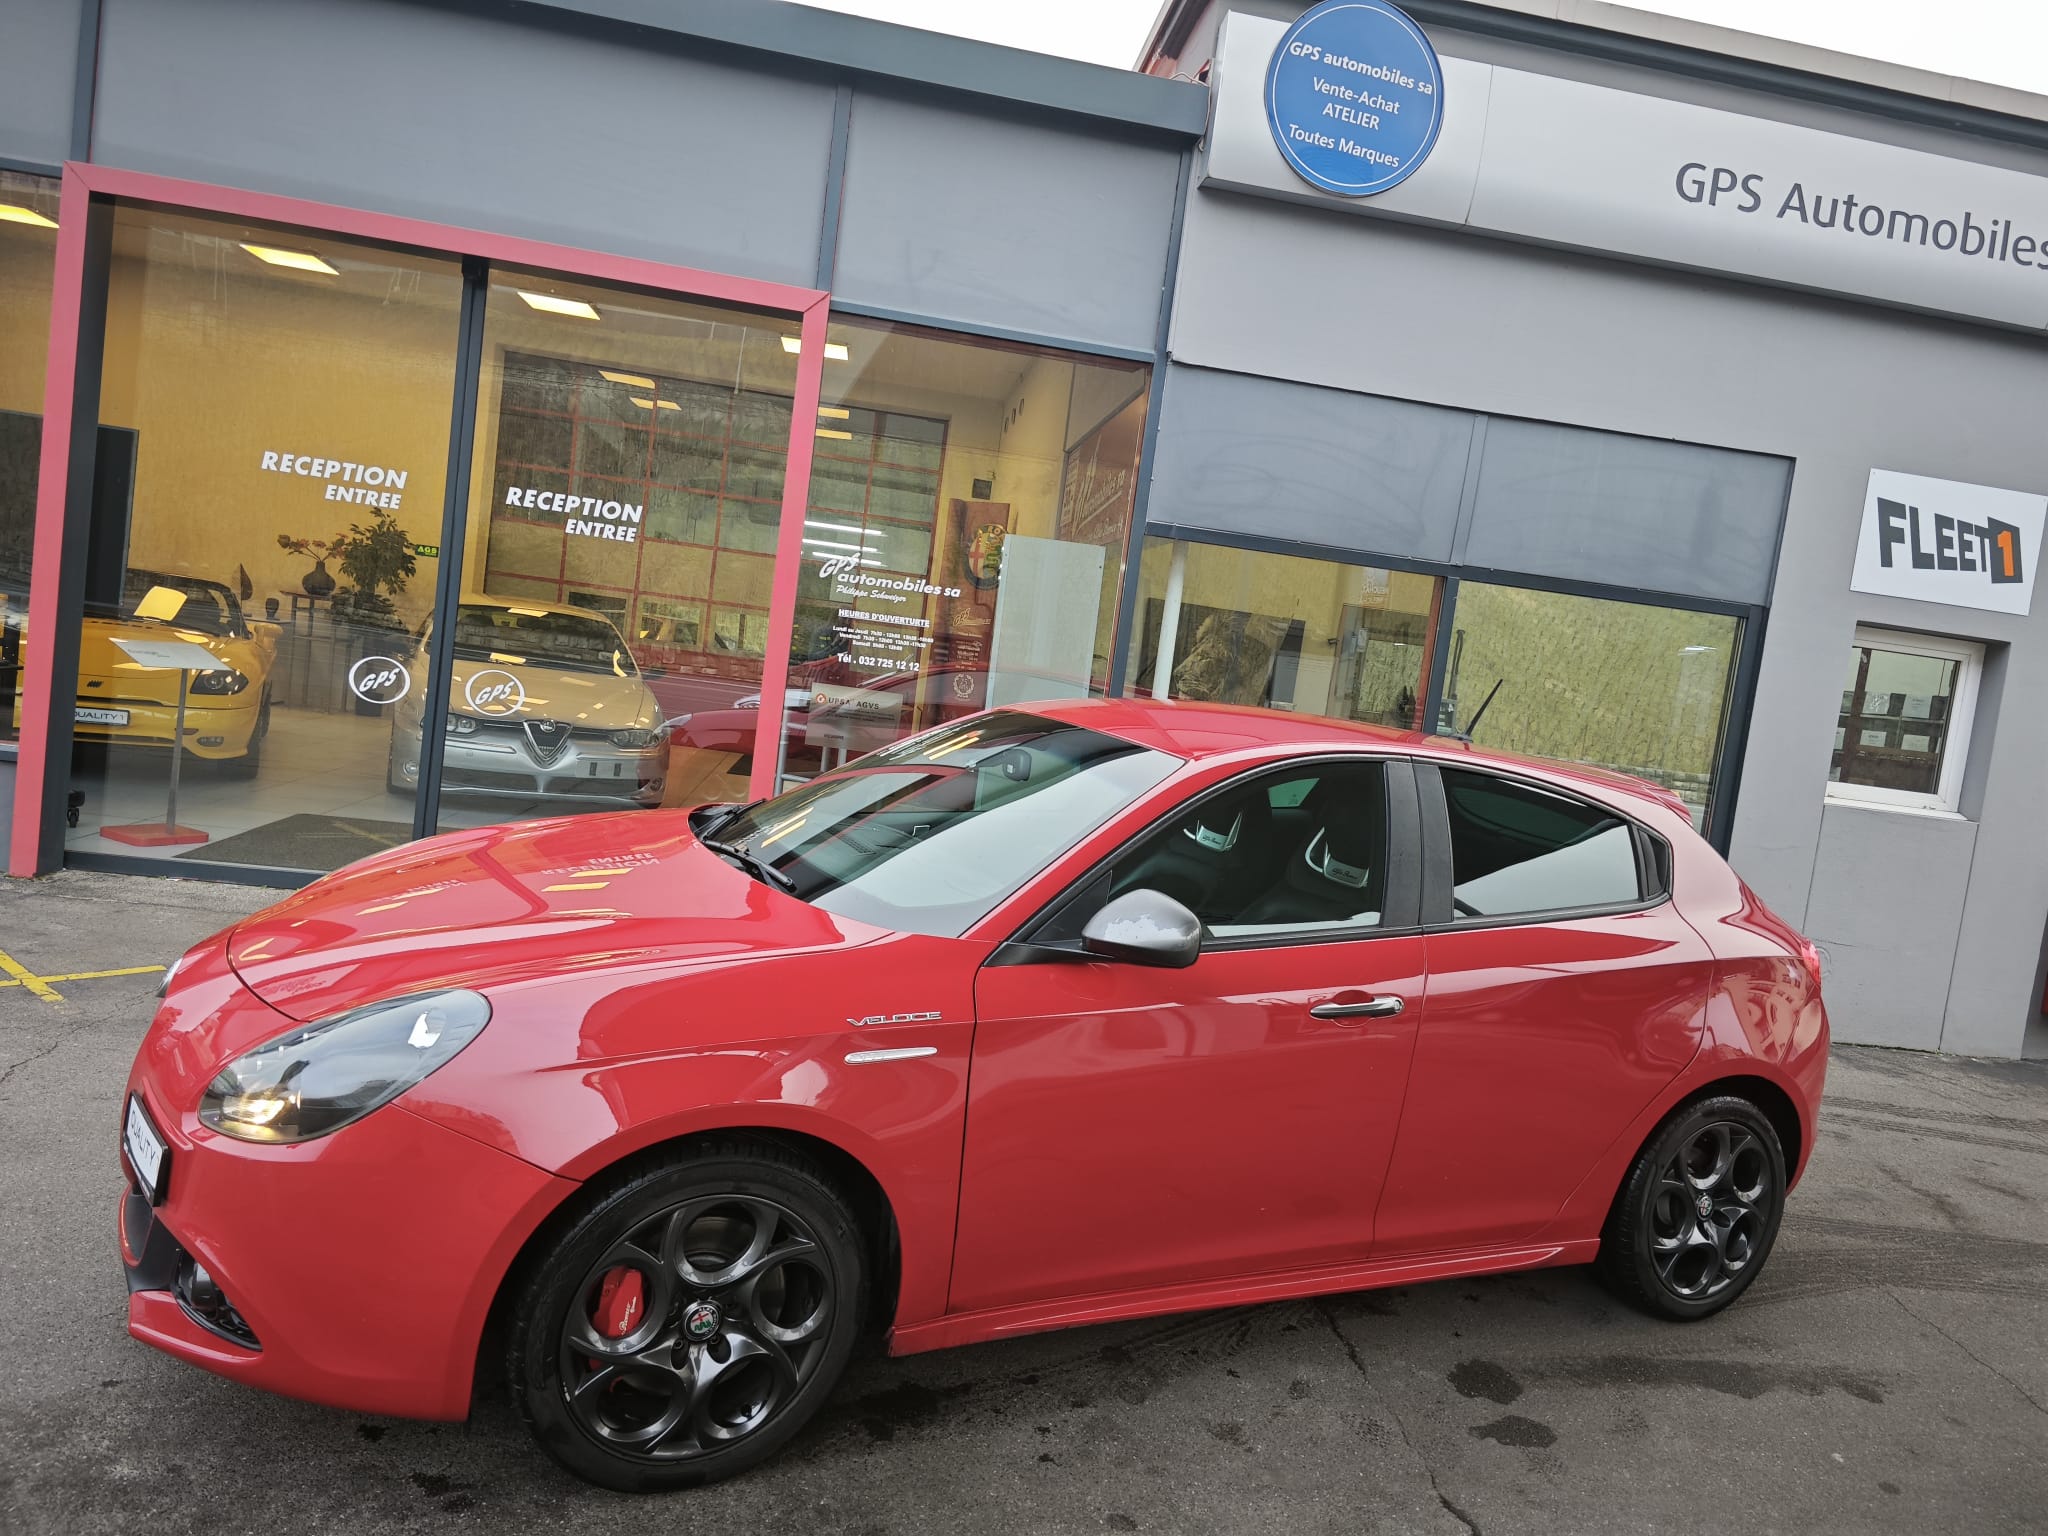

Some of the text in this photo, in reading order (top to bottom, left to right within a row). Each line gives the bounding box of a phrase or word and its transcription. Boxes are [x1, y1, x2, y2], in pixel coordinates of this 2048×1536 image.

[1289, 41, 1433, 95] GPS automobiles sa
[1313, 76, 1400, 115] Vente-Achat
[1322, 102, 1380, 130] ATELIER
[1289, 124, 1400, 167] Toutes Marques
[1675, 162, 1764, 213] GPS
[261, 450, 408, 489] RECEPTION
[325, 484, 402, 509] ENTREE
[505, 486, 643, 523] RECEPTION
[565, 518, 637, 543] ENTREE
[818, 552, 861, 578] GPS
[836, 585, 868, 598] Philippe
[837, 573, 961, 598] automobiles sa
[838, 609, 870, 619] HEURES
[837, 653, 851, 663] Tél
[858, 656, 875, 667] 032
[877, 659, 893, 668] 725
[896, 660, 906, 670] 12
[909, 662, 919, 671] 12
[359, 667, 401, 692] GPS
[475, 681, 515, 705] GPS
[856, 701, 880, 710] AGVS
[846, 1011, 942, 1026] VELOCE
